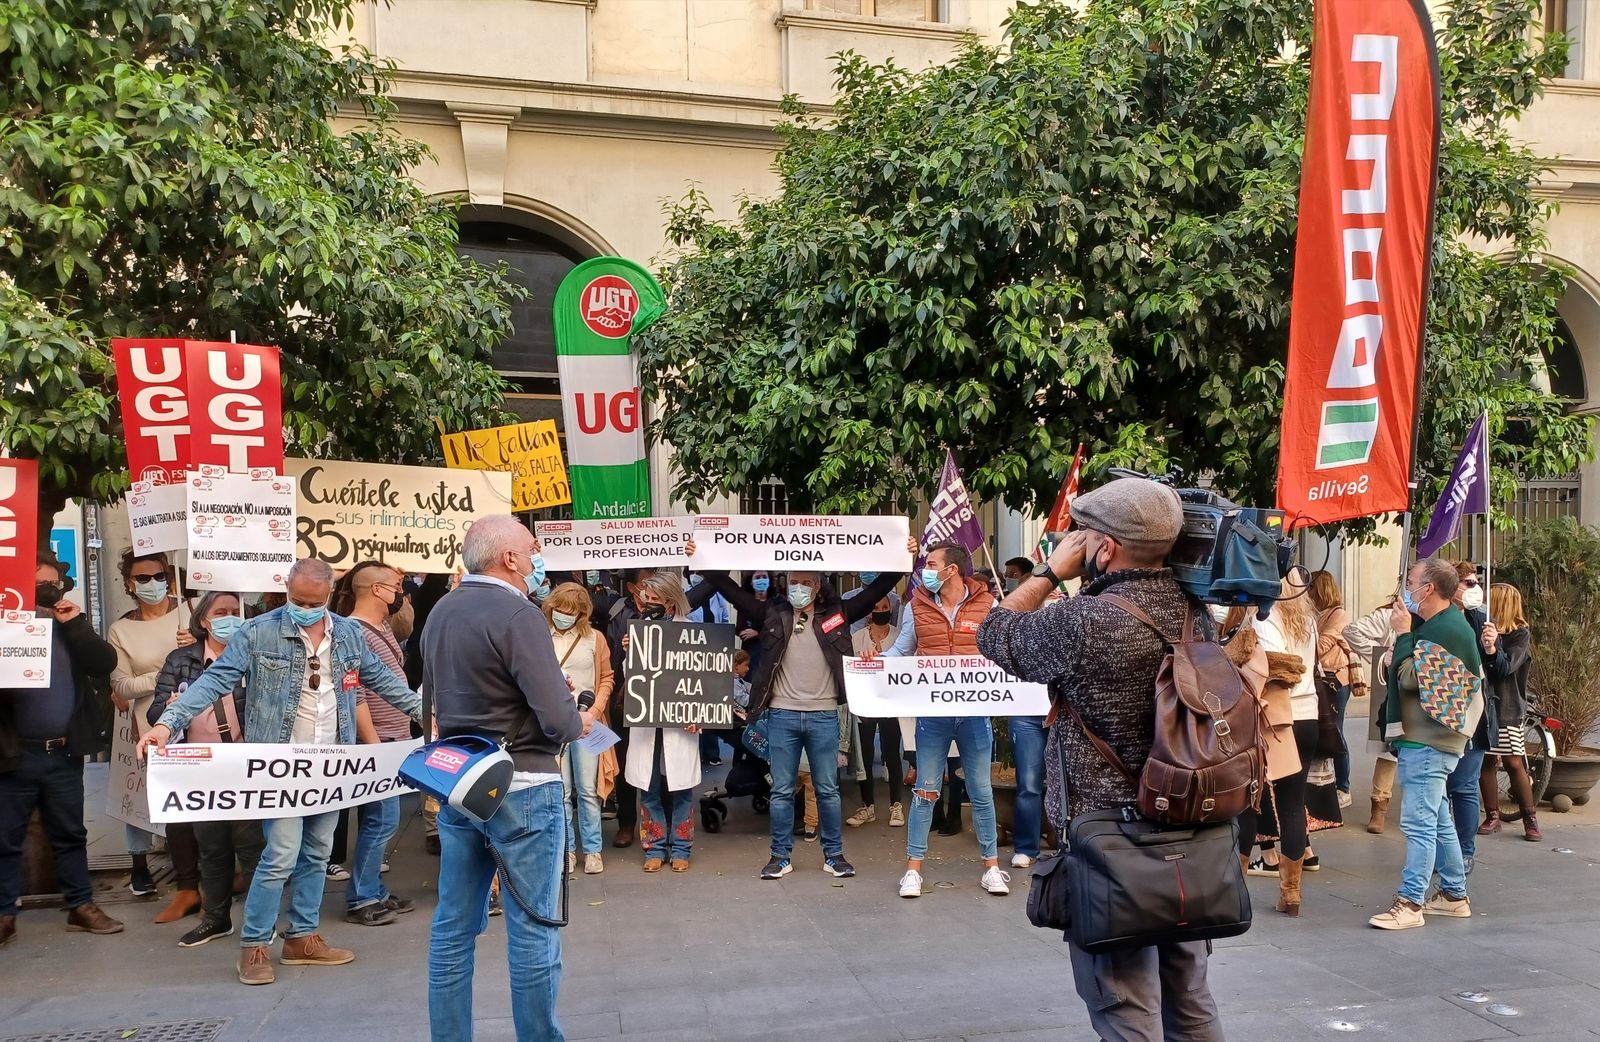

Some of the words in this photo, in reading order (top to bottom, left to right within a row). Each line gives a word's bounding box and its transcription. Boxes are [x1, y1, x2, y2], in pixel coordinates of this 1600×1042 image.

[589, 286, 633, 312] UGT
[129, 347, 191, 462] UGT
[207, 350, 265, 474] UGT
[575, 387, 640, 435] UG
[448, 434, 490, 465] No
[530, 455, 563, 477] FALTA
[299, 466, 400, 508] Cuéntele
[414, 480, 475, 516] usted
[139, 516, 148, 528] SAS
[147, 512, 172, 525] MALTRATA
[176, 510, 187, 522] SUS
[199, 503, 203, 513] A
[203, 503, 211, 514] LA
[244, 503, 254, 515] NO
[254, 506, 258, 515] A
[258, 505, 265, 516] LA
[265, 505, 292, 517] IMPOSICIÓN
[336, 511, 364, 525] sus
[600, 520, 634, 530] SALUD
[636, 519, 677, 529] MENTAL
[759, 517, 796, 527] SALUD
[799, 517, 843, 527] MENTAL
[352, 532, 430, 563] psiquiatras
[544, 536, 572, 547] POR
[576, 535, 603, 546] LOS
[606, 533, 679, 545] DERECHOS
[682, 532, 694, 542] D
[714, 532, 748, 544] POR
[752, 532, 787, 545] UNA
[789, 533, 884, 546] ASISTENCIA
[193, 550, 200, 560] NO
[205, 551, 215, 560] LOS
[215, 551, 259, 562] DESPLAZAMIENTOS
[260, 552, 293, 563] OBLIGATORIOS
[583, 546, 685, 559] PROFESIONALE
[774, 550, 824, 562] DIGNA
[2, 646, 48, 658] ESPECIALISTAS
[628, 624, 663, 671] NO
[665, 646, 733, 673] IMPOSICIÓN
[917, 658, 956, 669] SALUD
[888, 673, 912, 685] NO
[917, 672, 929, 685] A
[933, 672, 955, 685] LA
[960, 671, 1024, 684] MOVILI
[625, 670, 663, 723] SÍ
[930, 689, 1014, 703] FORZOSA
[659, 695, 732, 724] NEGOCIACIÓN
[246, 758, 312, 779] POR
[322, 756, 377, 777] UNA
[161, 786, 344, 813] ASISTENCIA
[350, 775, 408, 800] DIGN
